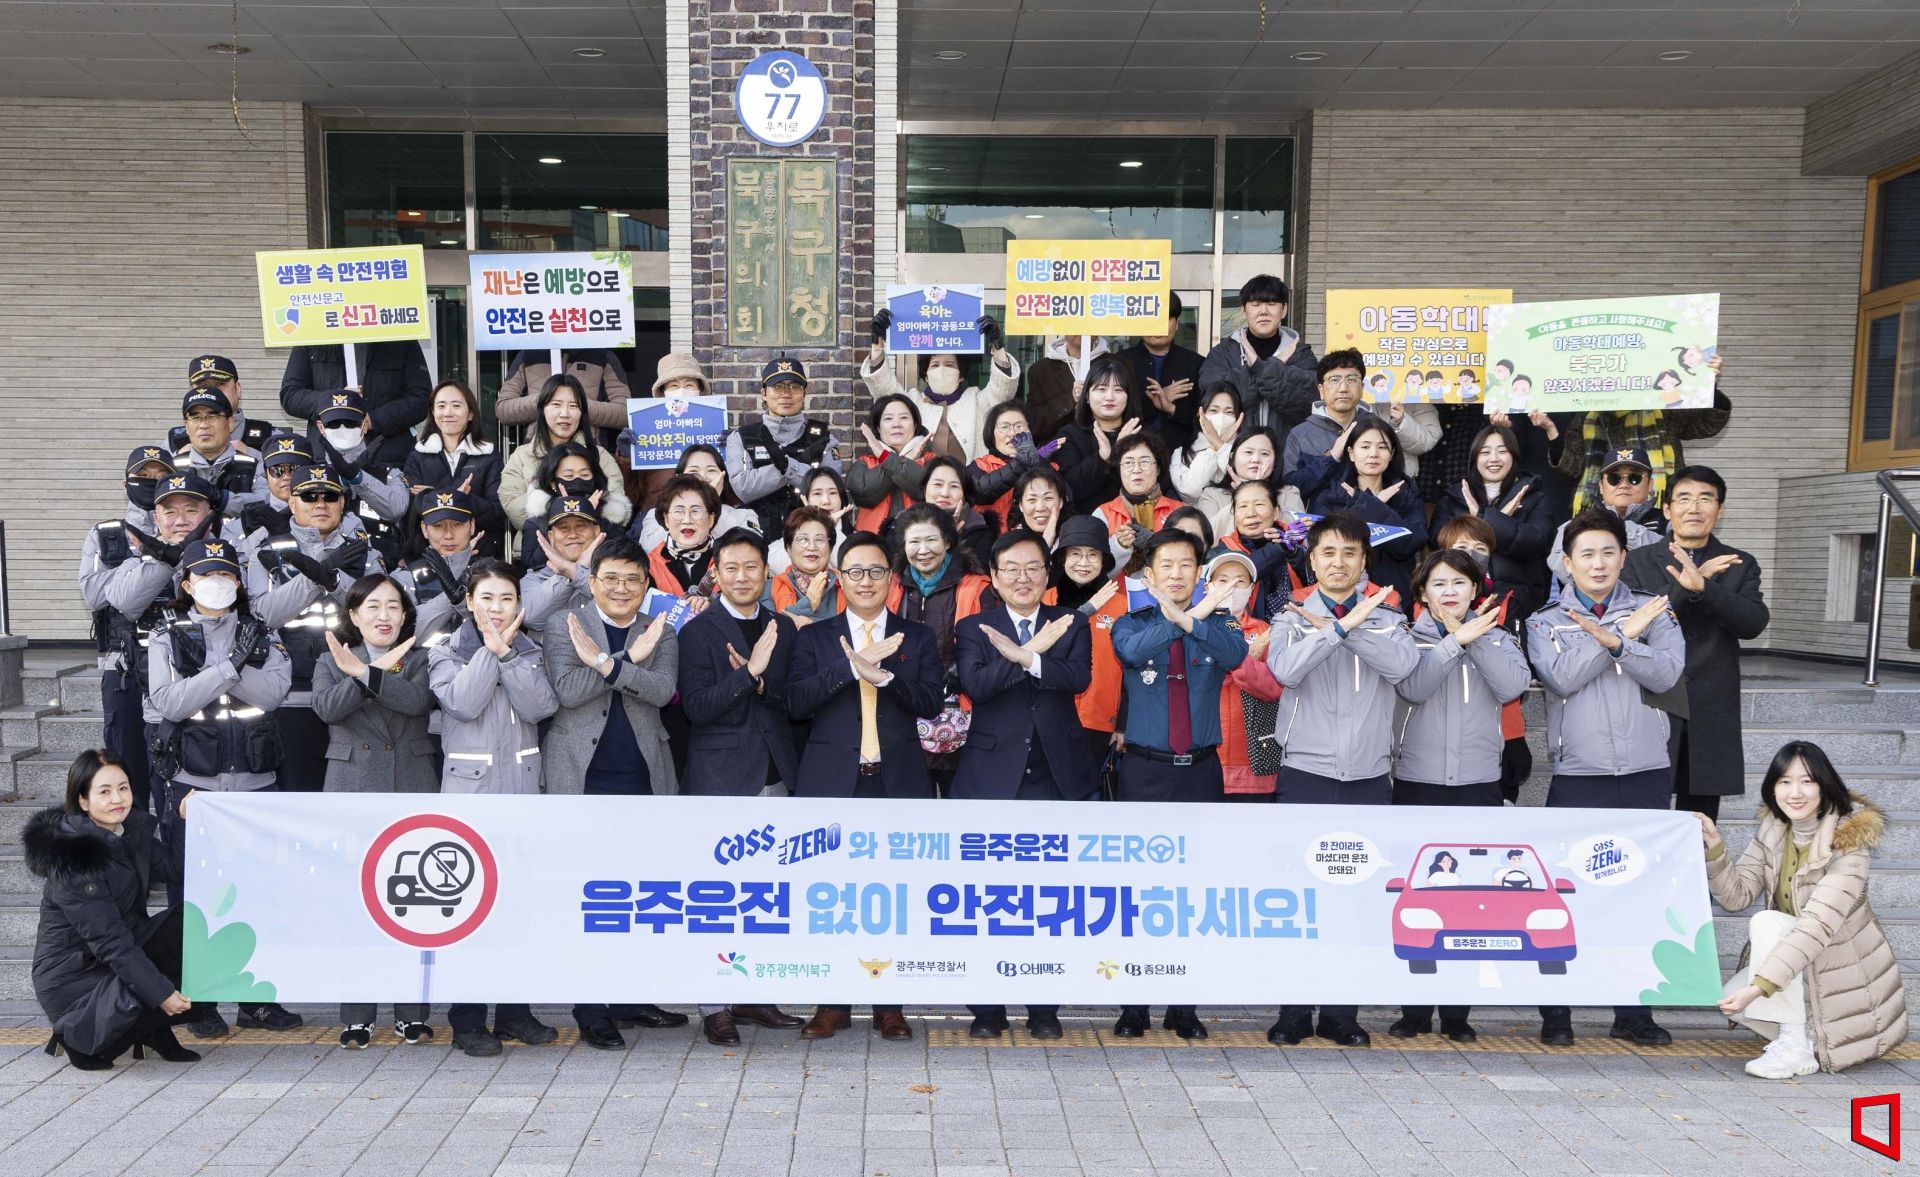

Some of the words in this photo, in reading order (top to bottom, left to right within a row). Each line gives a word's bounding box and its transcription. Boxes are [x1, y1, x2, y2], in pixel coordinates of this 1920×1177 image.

[764, 93, 801, 120] 77
[765, 121, 798, 132] 우치로
[735, 168, 762, 335] 북구의회
[788, 166, 833, 338] 북구청
[276, 263, 312, 285] 생활
[316, 263, 334, 283] 속
[337, 259, 408, 282] 안전위험
[1016, 258, 1086, 282] 예방없이
[1091, 258, 1161, 282] 안전없고
[483, 270, 540, 296] 재난은
[544, 268, 620, 295] 예방으로
[289, 292, 344, 307] 안전신문고
[1016, 294, 1085, 317] 안전없이
[1090, 294, 1161, 317] 행복없다
[919, 304, 953, 318] 육아는
[486, 308, 545, 335] 안전은
[549, 307, 622, 333] 실천으로
[896, 321, 939, 332] 엄마아빠가
[940, 321, 975, 332] 공동으로
[909, 334, 933, 348] 함께
[935, 336, 964, 347] 합니다.
[1378, 336, 1407, 351] 작은
[1411, 337, 1468, 351] 관심으로
[1553, 333, 1647, 351] 아동학대예방,
[1362, 352, 1405, 367] 예방할
[1409, 352, 1423, 367] 수
[1569, 353, 1627, 374] 북구가
[1543, 375, 1652, 394] 앞장서겠습니다!
[189, 393, 217, 402] POLICE
[637, 432, 694, 448] 육아휴직이
[778, 839, 788, 866] ALL
[788, 822, 841, 865] ZERO
[848, 831, 878, 860] 와
[887, 832, 950, 861] 함께
[959, 833, 1069, 862] 음주운전
[1320, 841, 1329, 851] 한
[1330, 841, 1364, 851] 잔이라도
[1315, 853, 1350, 863] 마셨다면
[1351, 853, 1369, 863] 운전
[1592, 847, 1622, 872] ZERO
[1327, 865, 1357, 875] 안돼요!
[581, 880, 790, 934] 음주운전
[806, 881, 908, 936] 없이
[926, 882, 1319, 940] 안전귀가하세요!
[1453, 938, 1487, 948] 음주운전
[1489, 939, 1519, 948] ZERO
[754, 963, 831, 978] 광주광역시북구
[896, 960, 966, 972] 광주북부경찰서
[996, 960, 1018, 977] OB
[1020, 962, 1066, 975] 오비맥주
[1125, 962, 1142, 976] OB
[1144, 963, 1187, 976] 좋은세상
